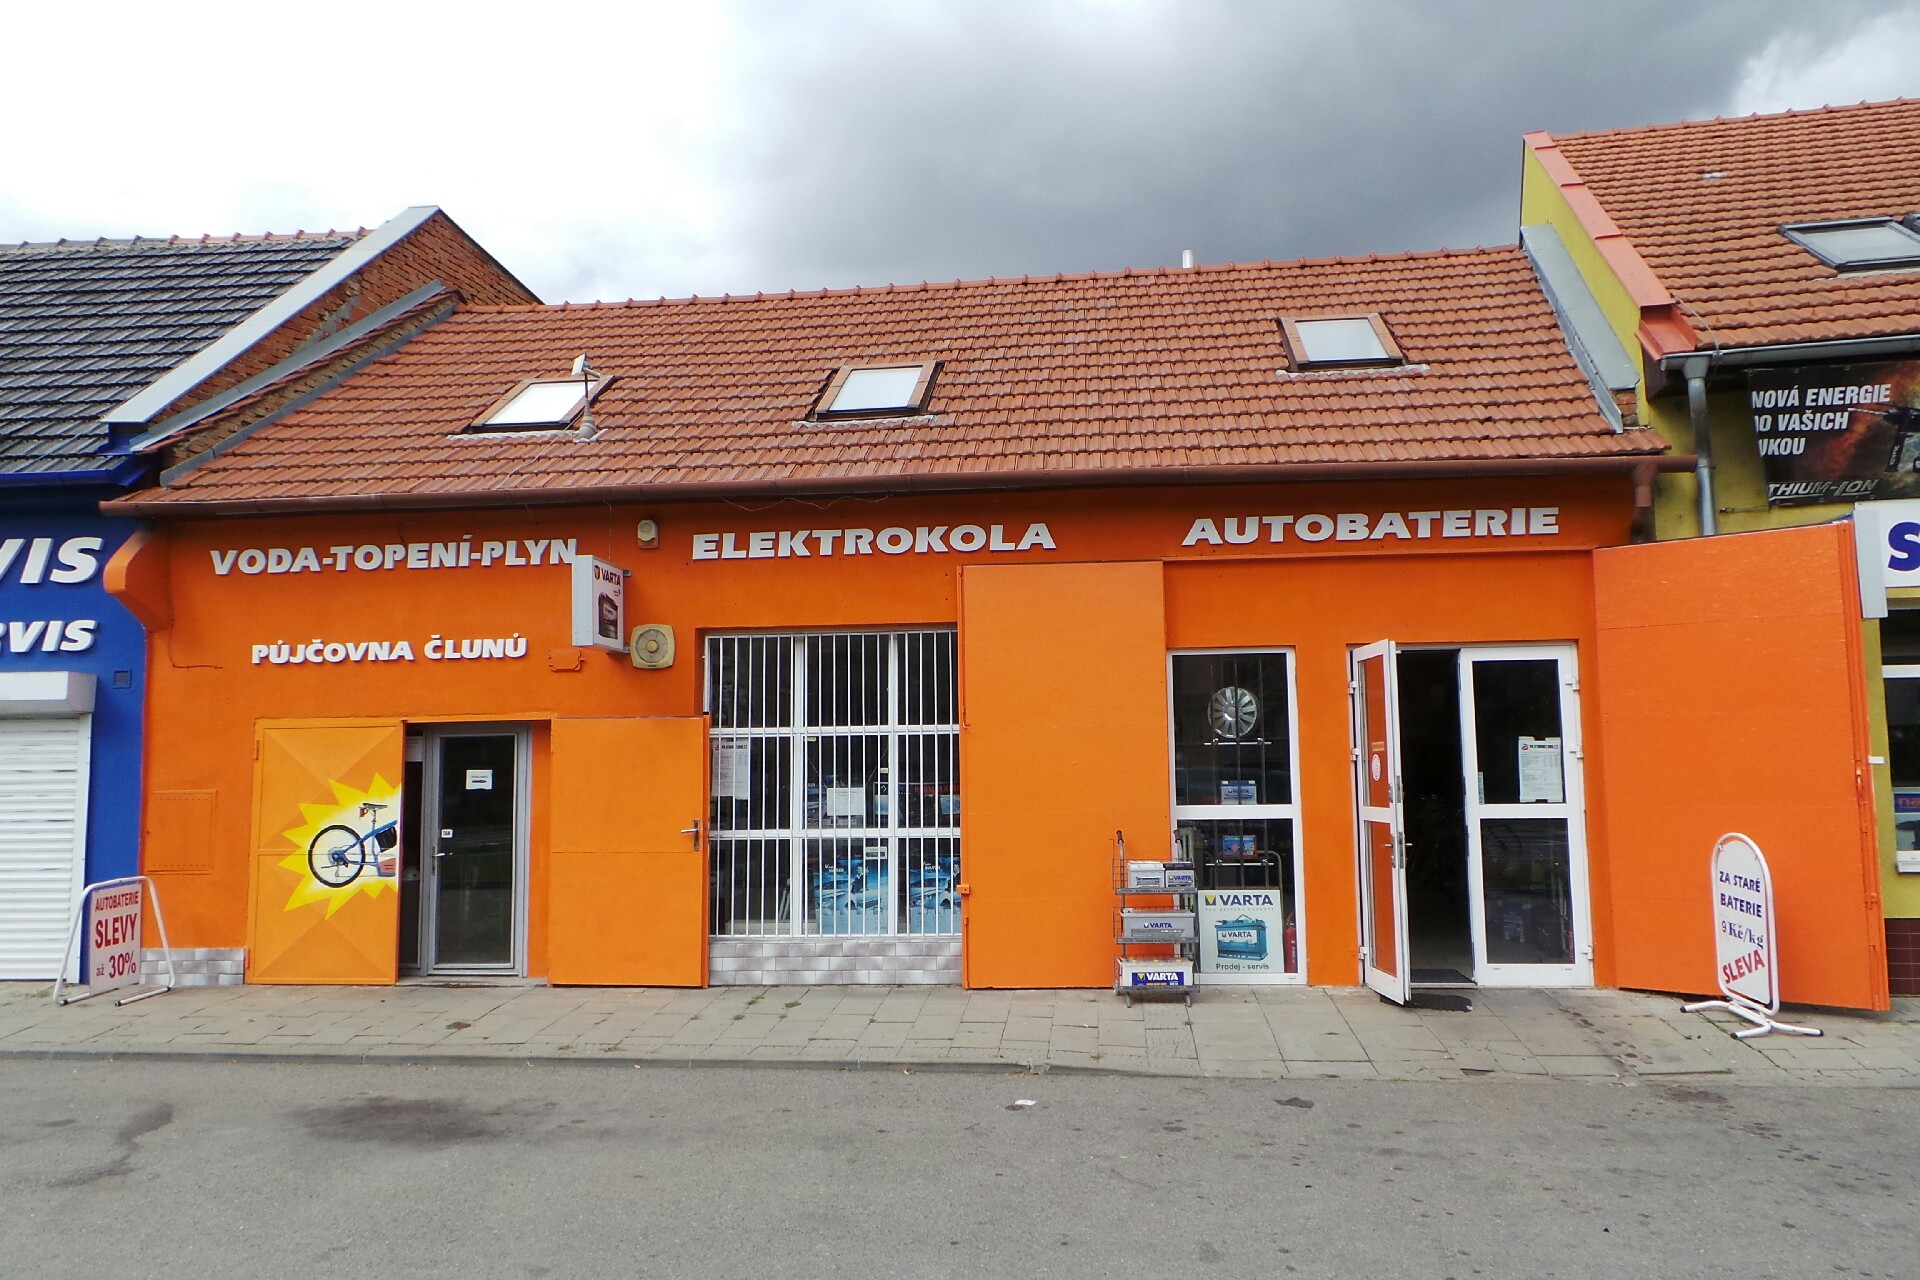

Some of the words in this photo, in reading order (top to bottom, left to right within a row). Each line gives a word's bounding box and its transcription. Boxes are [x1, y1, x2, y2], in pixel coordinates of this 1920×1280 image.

[1752, 385, 1799, 409] NOVÁ
[1805, 384, 1892, 407] ENERGIE
[1754, 413, 1772, 434] O
[1777, 410, 1850, 432] VAŠICH
[1181, 506, 1560, 546] AUTOBATERIE
[210, 534, 577, 575] VODA-TOPENÍ-PLYN
[692, 523, 1057, 560] ELEKTROKOLA
[601, 568, 621, 587] VARTA
[0, 619, 98, 653] VIS
[251, 639, 415, 665] PŮJČOVNA
[424, 632, 527, 660] ČLUNŮ
[1719, 871, 1731, 885] ZA
[1733, 875, 1761, 893] STARÉ
[95, 891, 139, 912] AUTOBATERIE
[1219, 894, 1273, 906] VARTA
[1720, 893, 1762, 918] BATERIE
[95, 913, 137, 949] SLEVY
[1721, 920, 1727, 933] 9
[1728, 921, 1764, 950] Kč/kg
[96, 963, 105, 977] až
[109, 951, 137, 979] 30%
[1146, 973, 1179, 981] VARTA
[1216, 963, 1241, 971] Prodej
[1722, 949, 1766, 984] SLEVA
